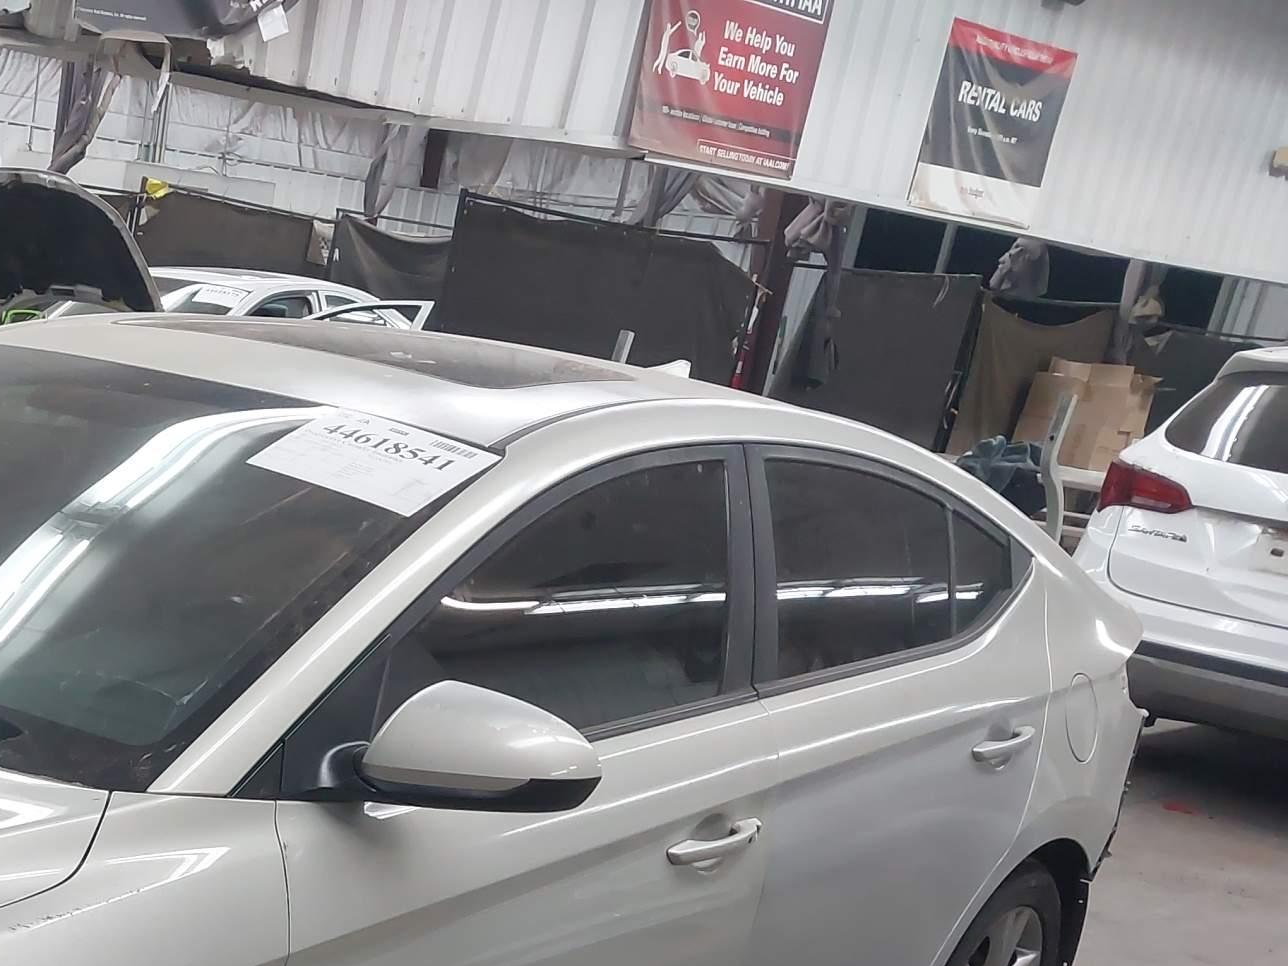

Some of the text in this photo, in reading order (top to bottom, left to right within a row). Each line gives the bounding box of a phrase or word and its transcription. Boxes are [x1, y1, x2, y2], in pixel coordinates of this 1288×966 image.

[723, 20, 796, 57] We Help You
[718, 47, 799, 84] Earn More For
[713, 72, 784, 106] Your Vehicle
[958, 80, 1043, 122] RENTAL CARS
[322, 423, 456, 472] 44618541
